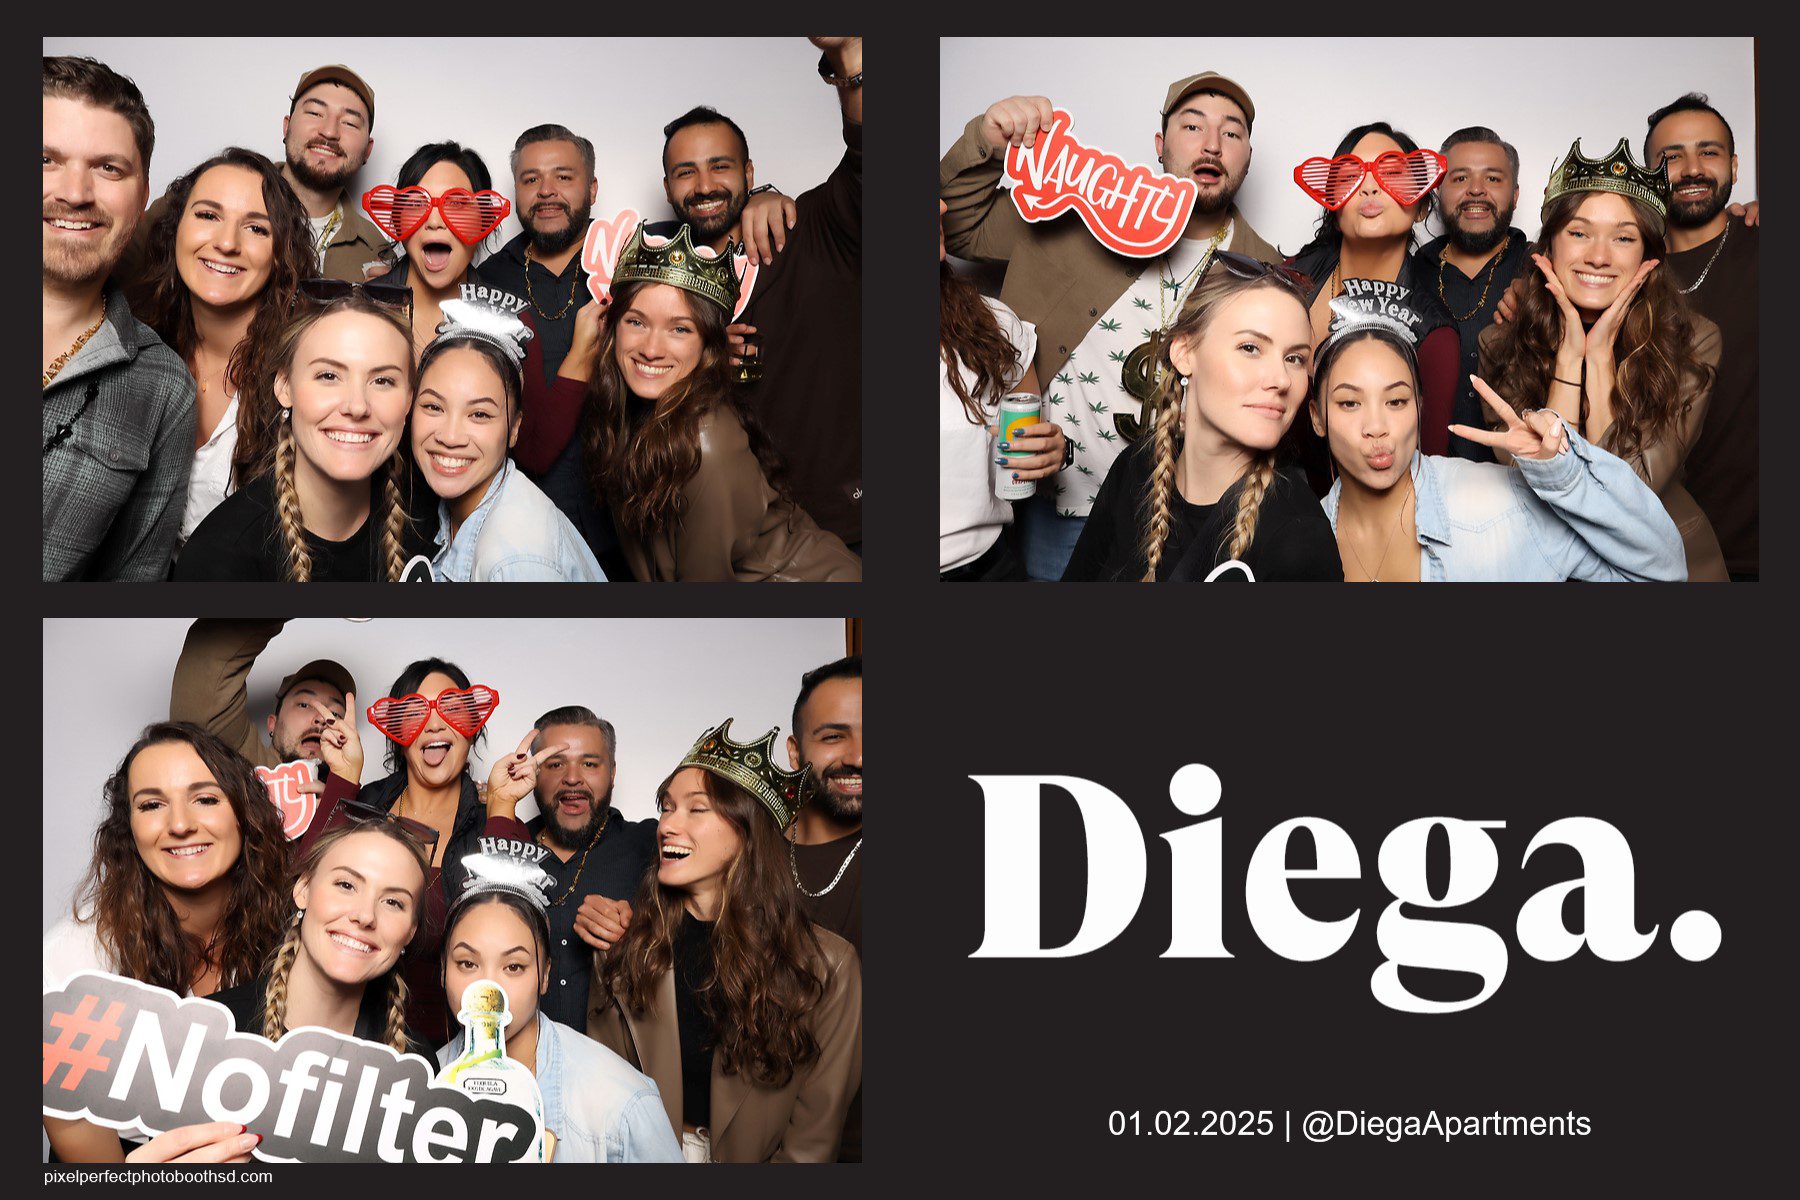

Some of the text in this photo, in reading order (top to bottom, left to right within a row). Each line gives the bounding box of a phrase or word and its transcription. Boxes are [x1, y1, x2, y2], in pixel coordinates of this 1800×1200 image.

[1016, 119, 1186, 238] NAUGHTY
[460, 283, 528, 312] Happy
[1343, 279, 1411, 301] Happy
[1377, 296, 1421, 327] Year
[479, 836, 548, 863] Happy
[43, 995, 518, 1163] #Nofilter
